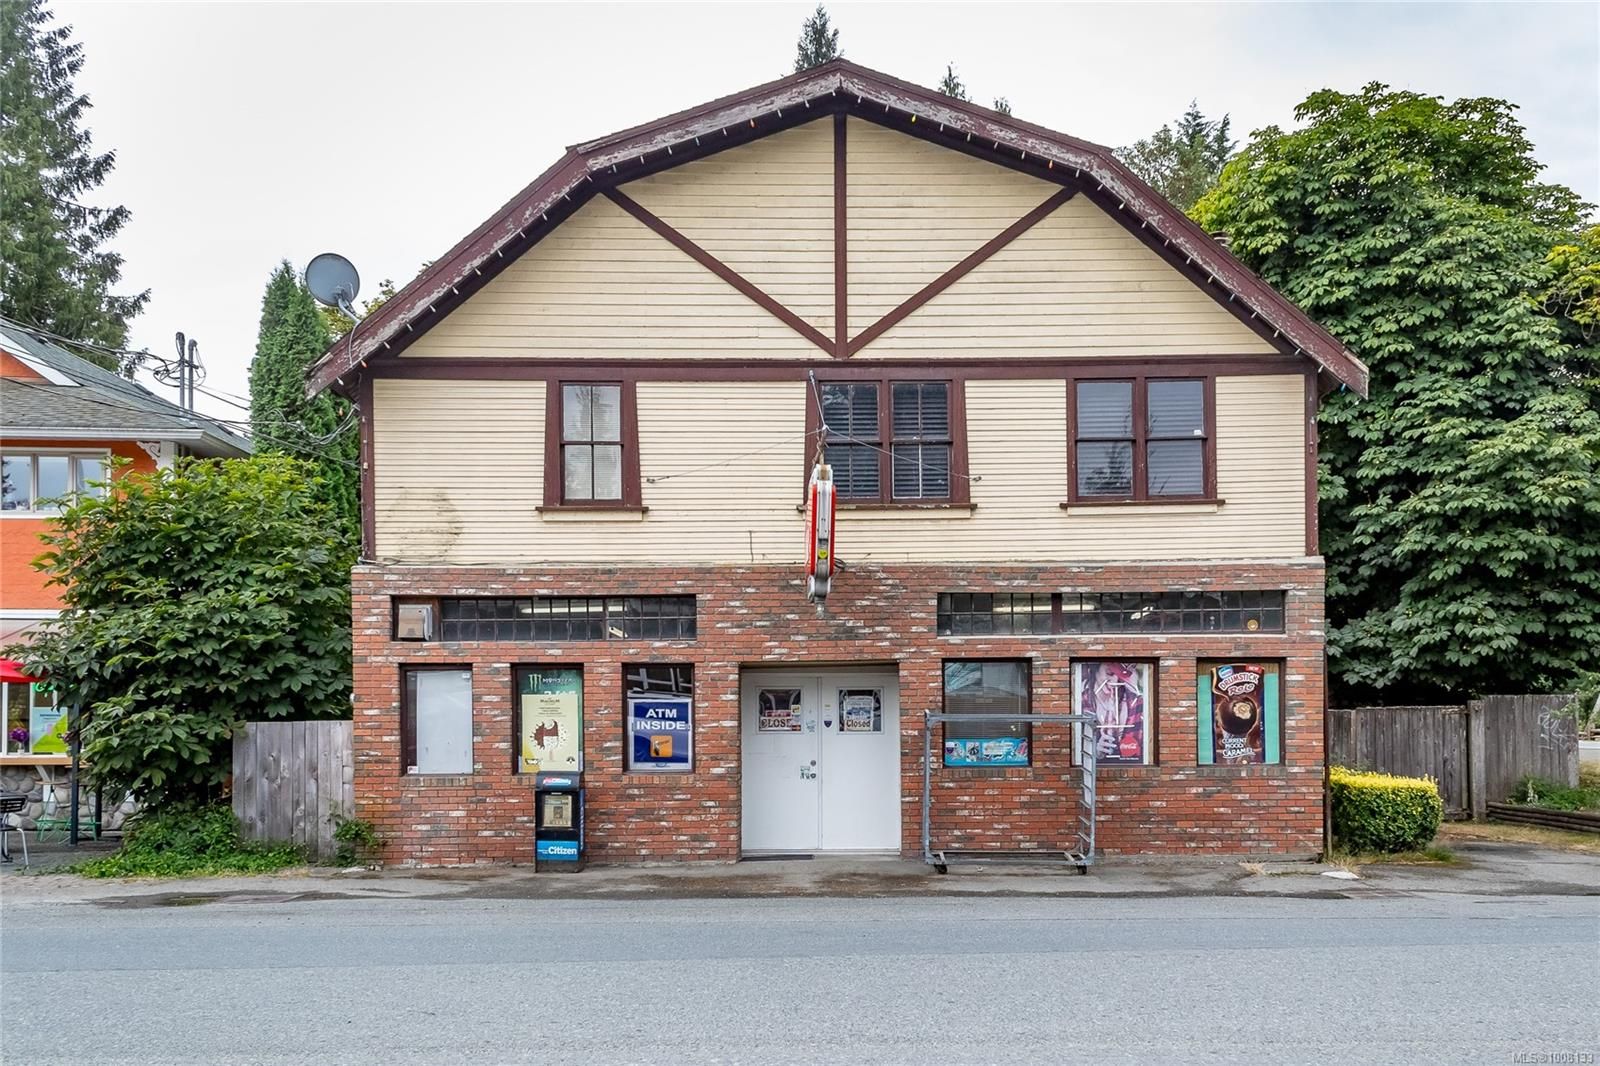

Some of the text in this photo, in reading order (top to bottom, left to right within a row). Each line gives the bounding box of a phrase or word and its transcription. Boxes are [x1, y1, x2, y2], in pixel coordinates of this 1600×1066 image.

[1218, 672, 1259, 691] DRUMSTICK
[645, 708, 677, 718] ATM
[636, 720, 686, 730] INSIDE
[846, 719, 871, 728] Closed
[1222, 747, 1254, 757] CARAMEL
[548, 846, 578, 855] Citizen
